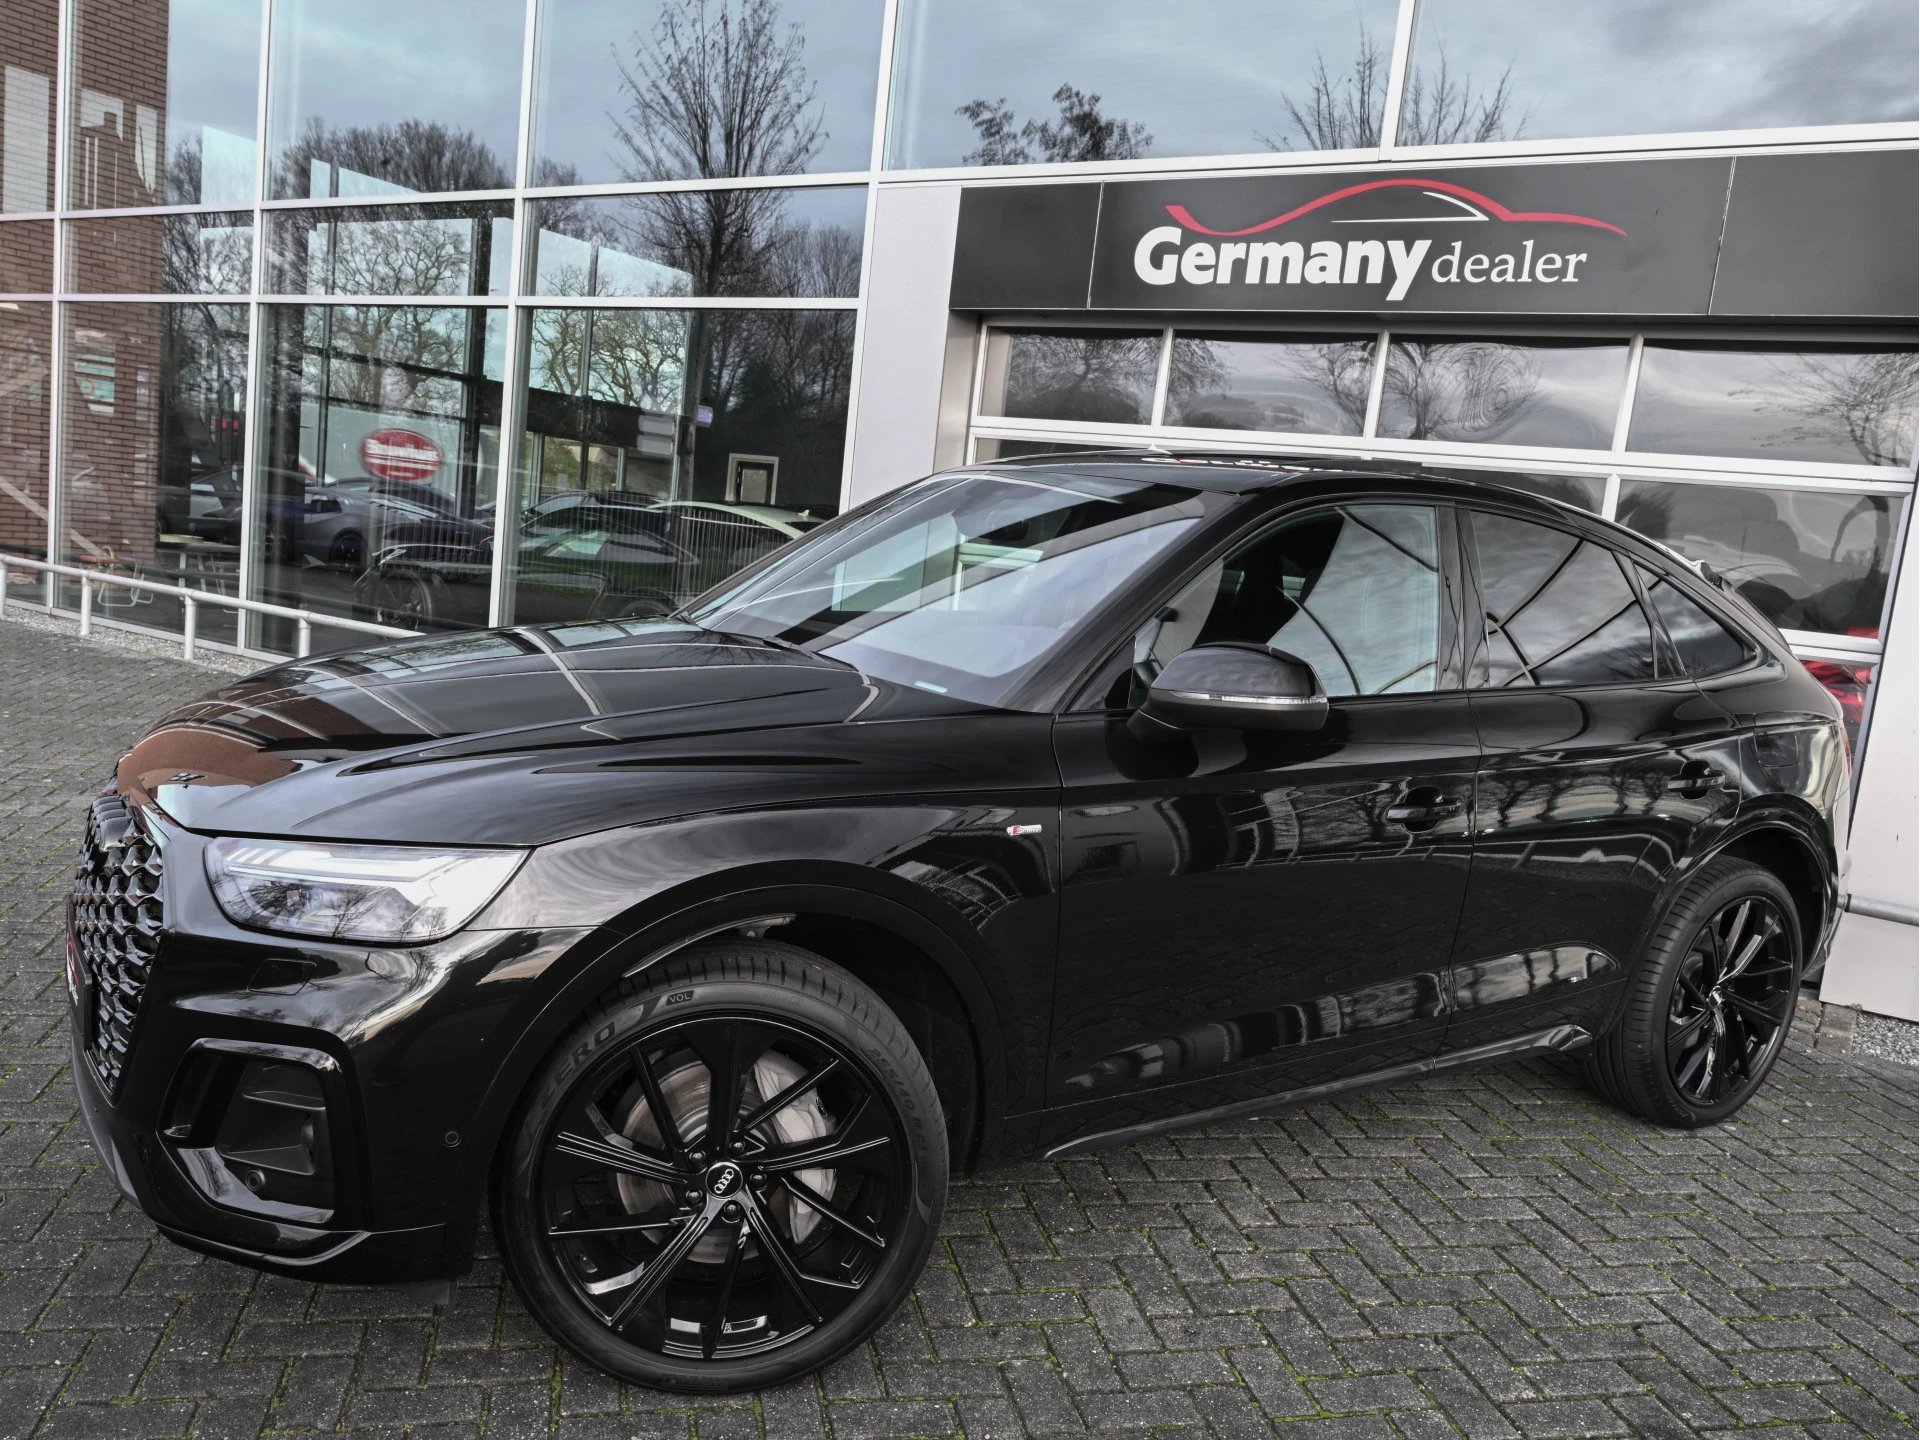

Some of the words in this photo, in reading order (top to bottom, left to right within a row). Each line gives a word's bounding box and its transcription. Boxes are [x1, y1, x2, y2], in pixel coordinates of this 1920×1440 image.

[1134, 226, 1433, 301] Germany
[1431, 240, 1588, 284] dealer
[669, 992, 692, 1004] VOL
